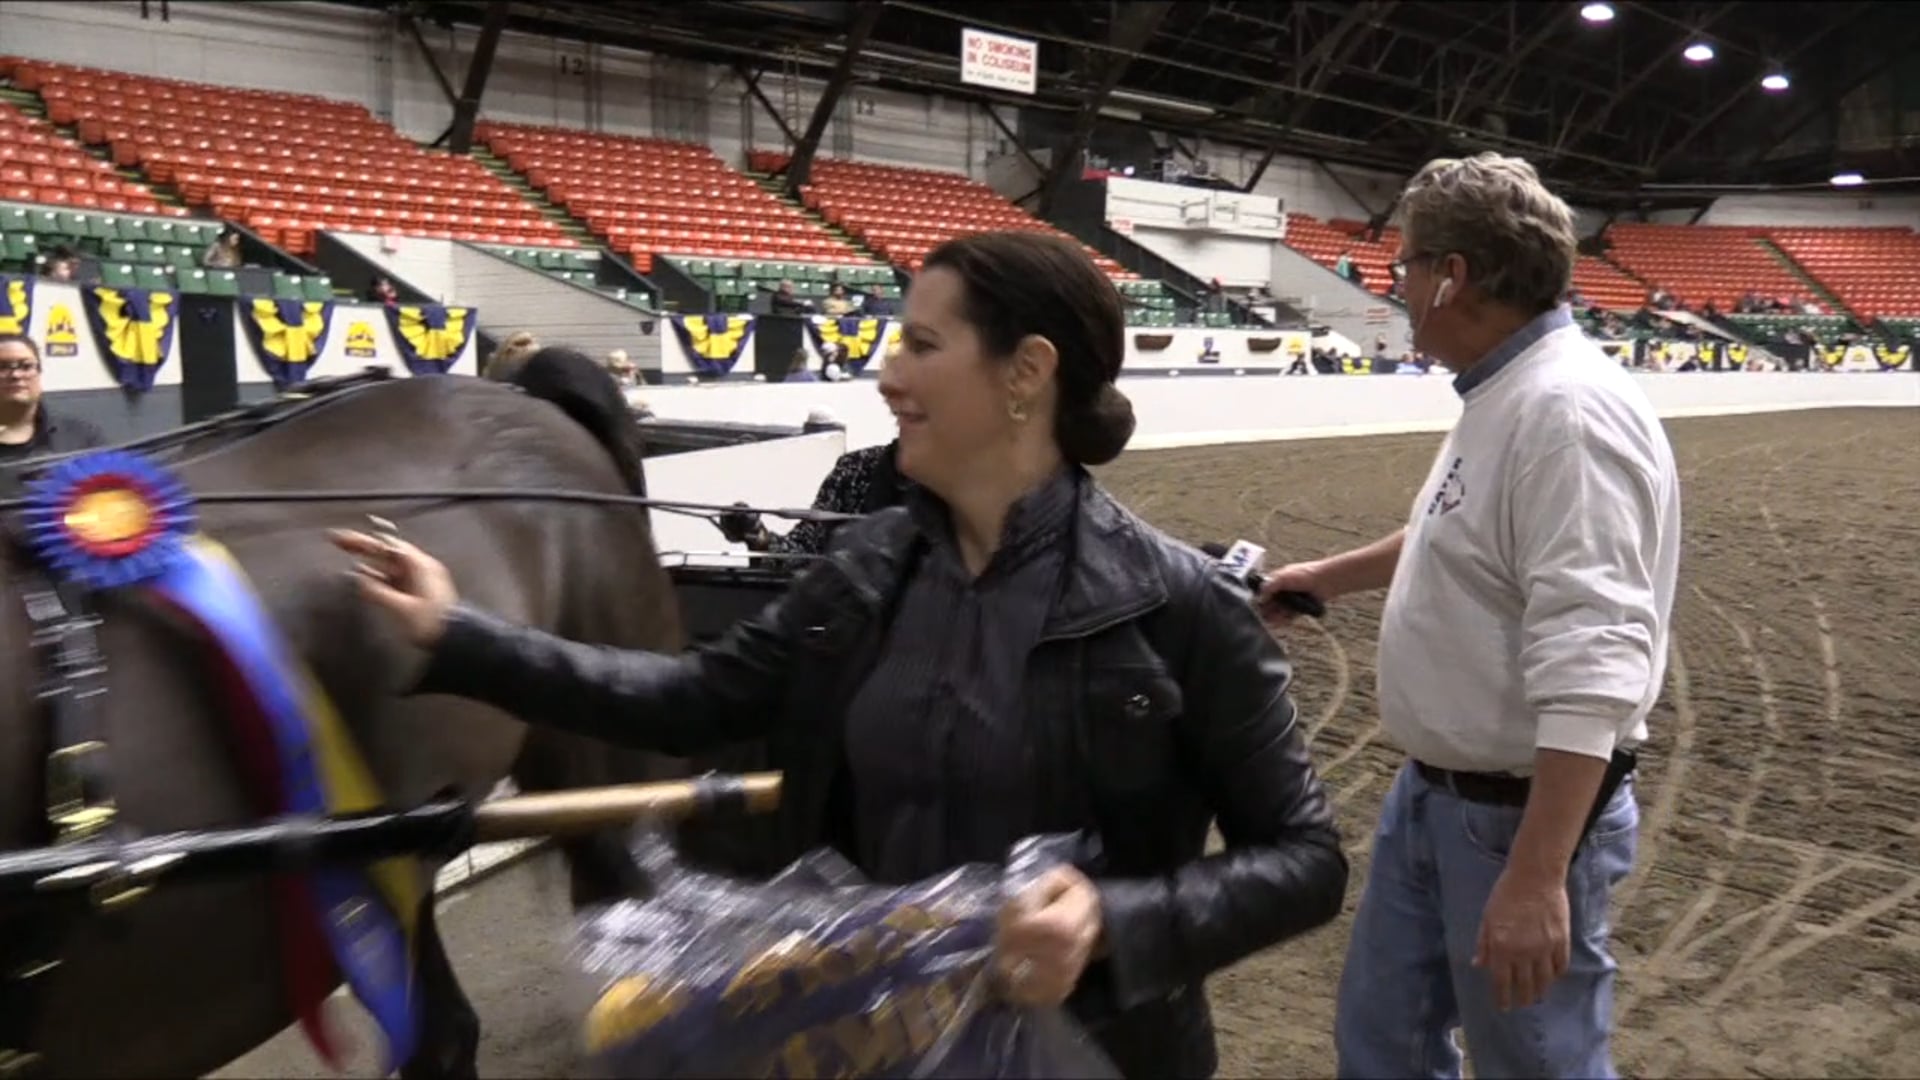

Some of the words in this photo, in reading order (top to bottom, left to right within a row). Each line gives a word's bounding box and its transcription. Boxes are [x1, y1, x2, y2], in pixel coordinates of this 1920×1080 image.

[967, 37, 982, 49] NO
[988, 41, 1031, 59] SMOKING
[561, 55, 584, 75] 12
[967, 51, 977, 63] IN
[982, 54, 1031, 74] COLISEUM
